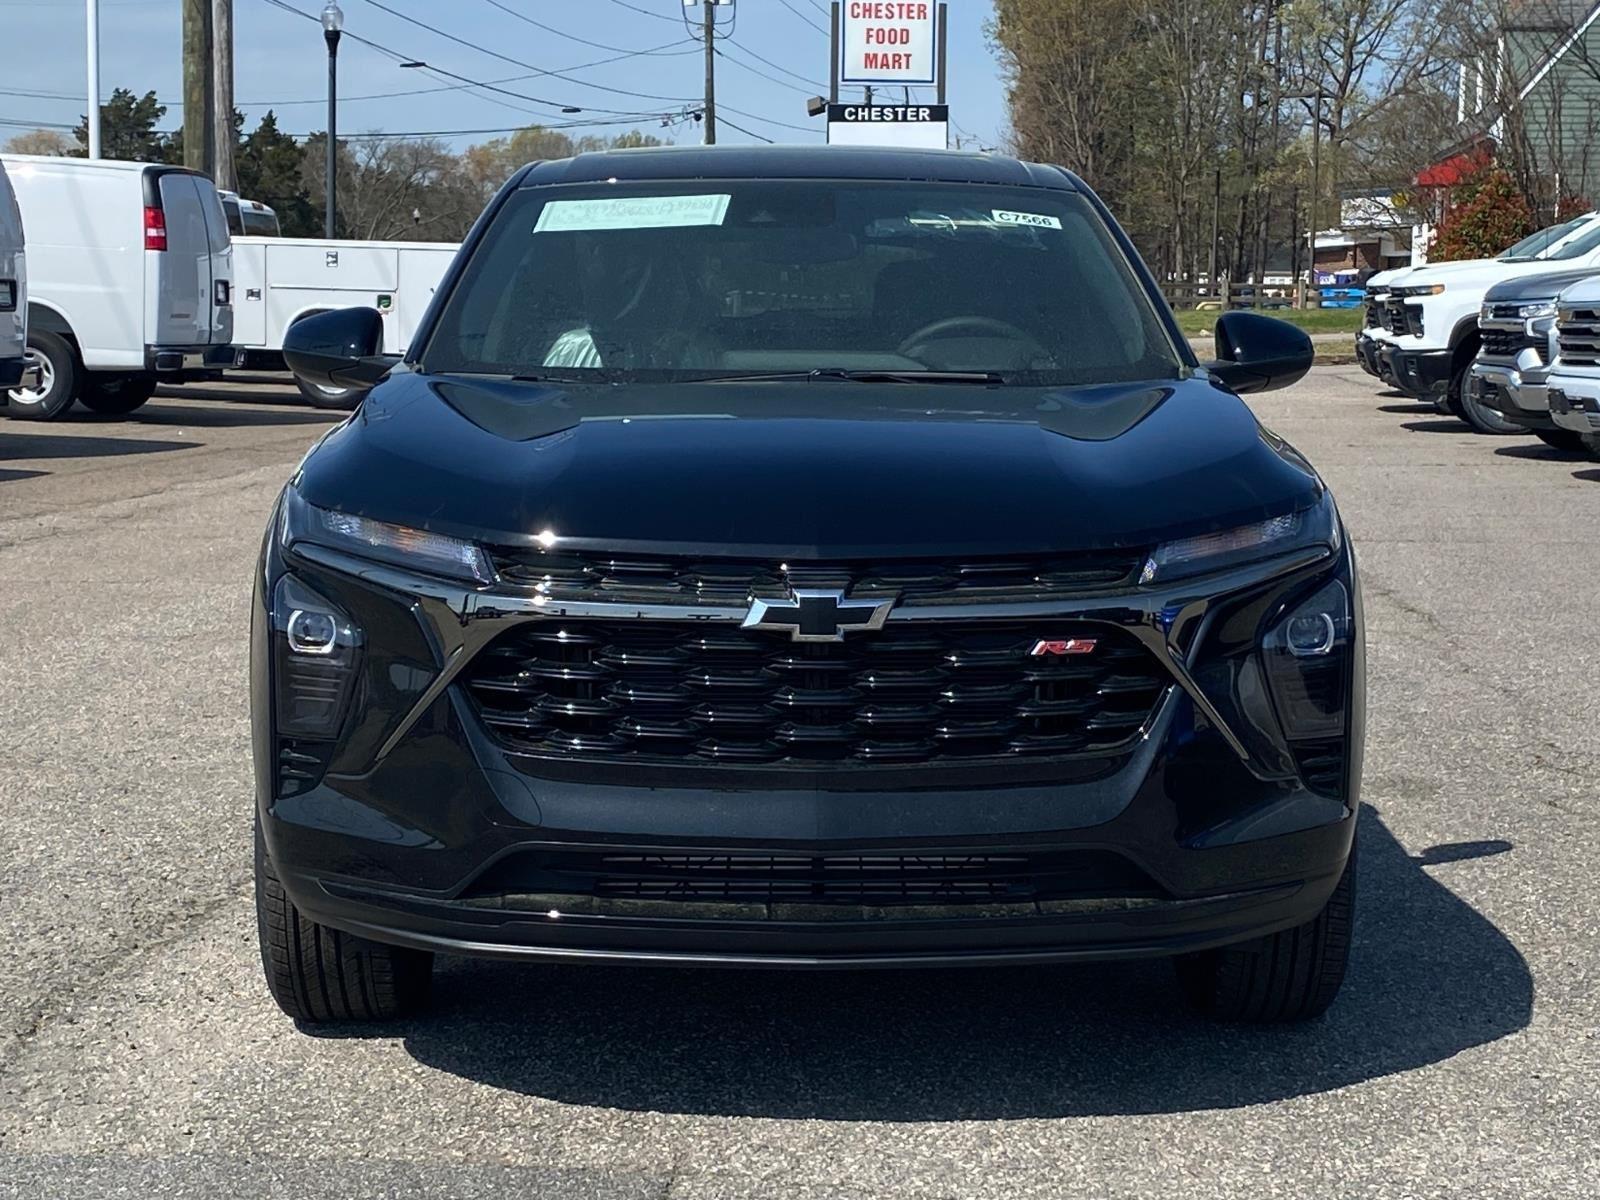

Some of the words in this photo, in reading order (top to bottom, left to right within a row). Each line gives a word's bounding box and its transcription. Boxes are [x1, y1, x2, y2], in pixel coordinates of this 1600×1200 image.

[851, 2, 927, 20] CHESTER
[866, 28, 910, 45] FOOD
[864, 53, 913, 70] MART
[844, 107, 930, 121] CHESTER
[999, 212, 1052, 227] C7566
[1030, 638, 1097, 656] RS
